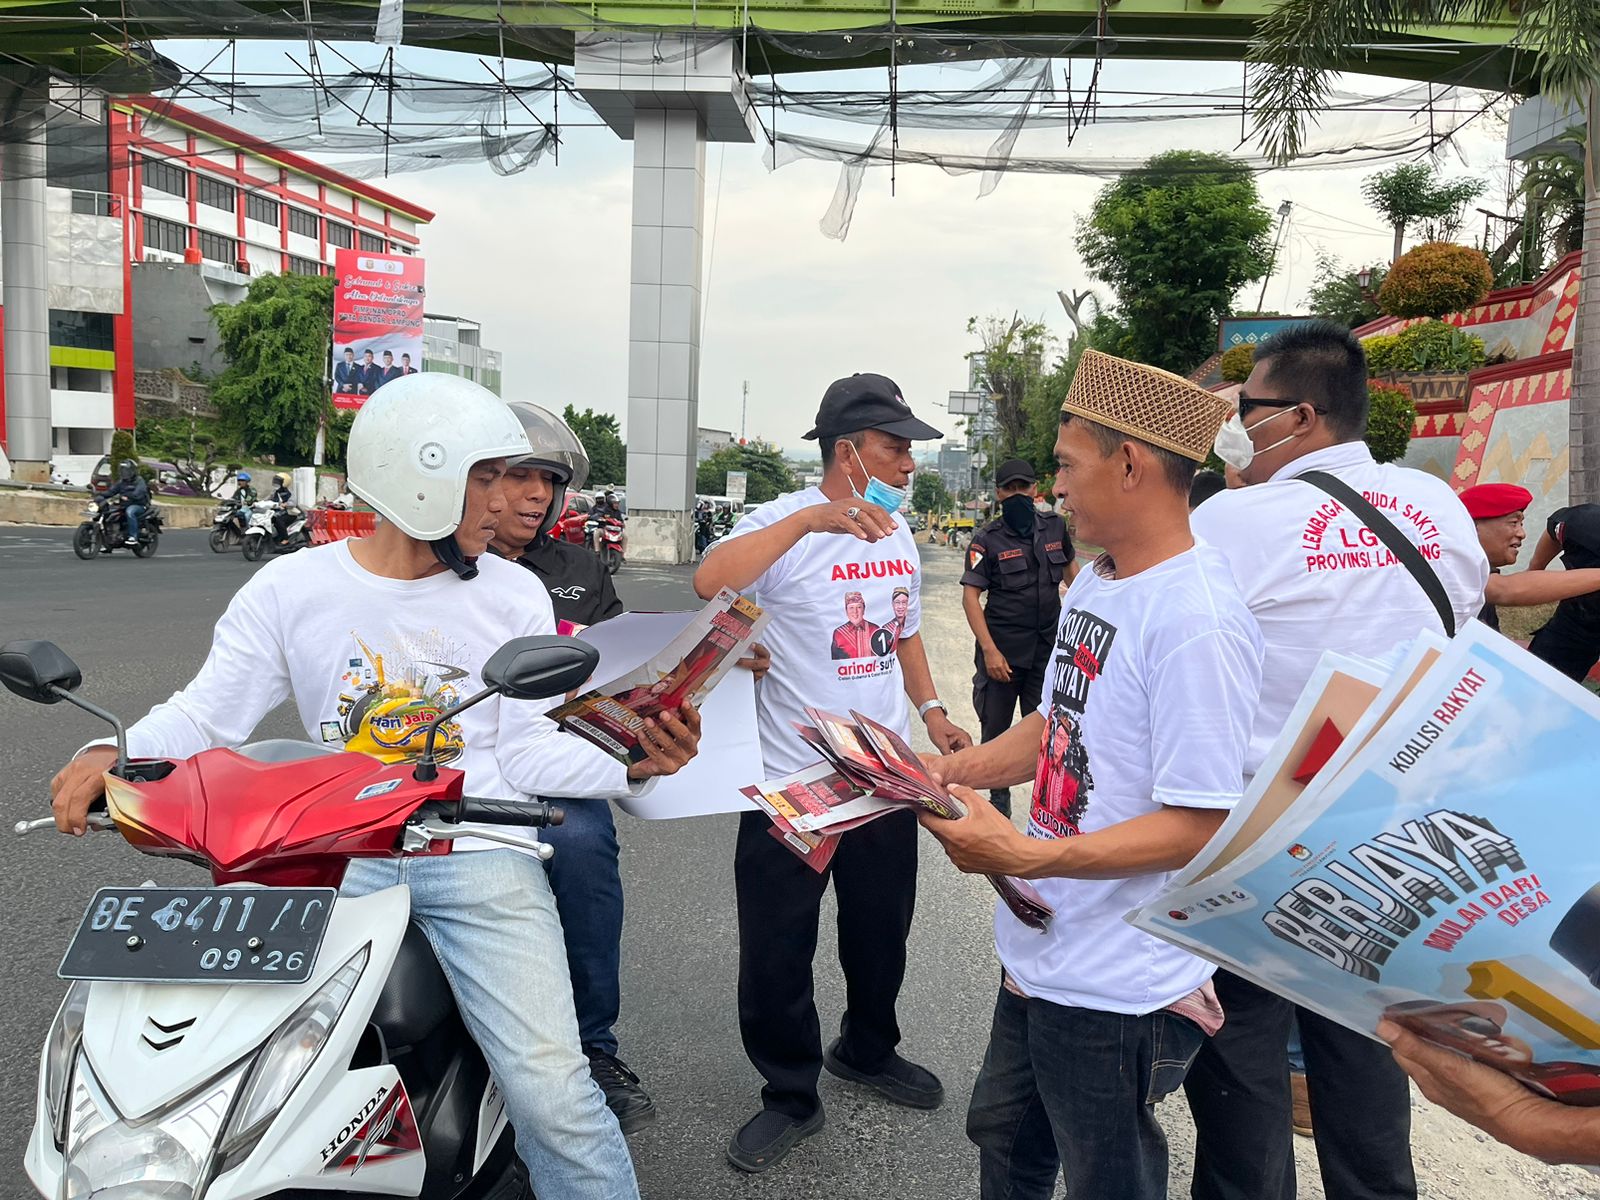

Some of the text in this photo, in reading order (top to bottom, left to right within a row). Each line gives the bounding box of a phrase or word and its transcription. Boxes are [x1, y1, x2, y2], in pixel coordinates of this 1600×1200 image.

[353, 305, 386, 315] PIMPINAN
[358, 315, 385, 324] BANDAR
[388, 318, 420, 327] LAMPUNG
[1302, 491, 1440, 551] LEMBAGA RUDA SAKTI
[1340, 528, 1379, 548] LG
[1306, 543, 1441, 573] PROVINSI LANG
[877, 632, 887, 653] 1
[370, 711, 434, 728] Hari Jala
[1389, 667, 1486, 774] KOALISI RAKYAT
[91, 896, 145, 932] BE
[1262, 809, 1528, 984] BERJAYA
[1423, 873, 1542, 953] MULAI DARI
[1497, 890, 1551, 928] DESA
[320, 1086, 388, 1163] HONDA
